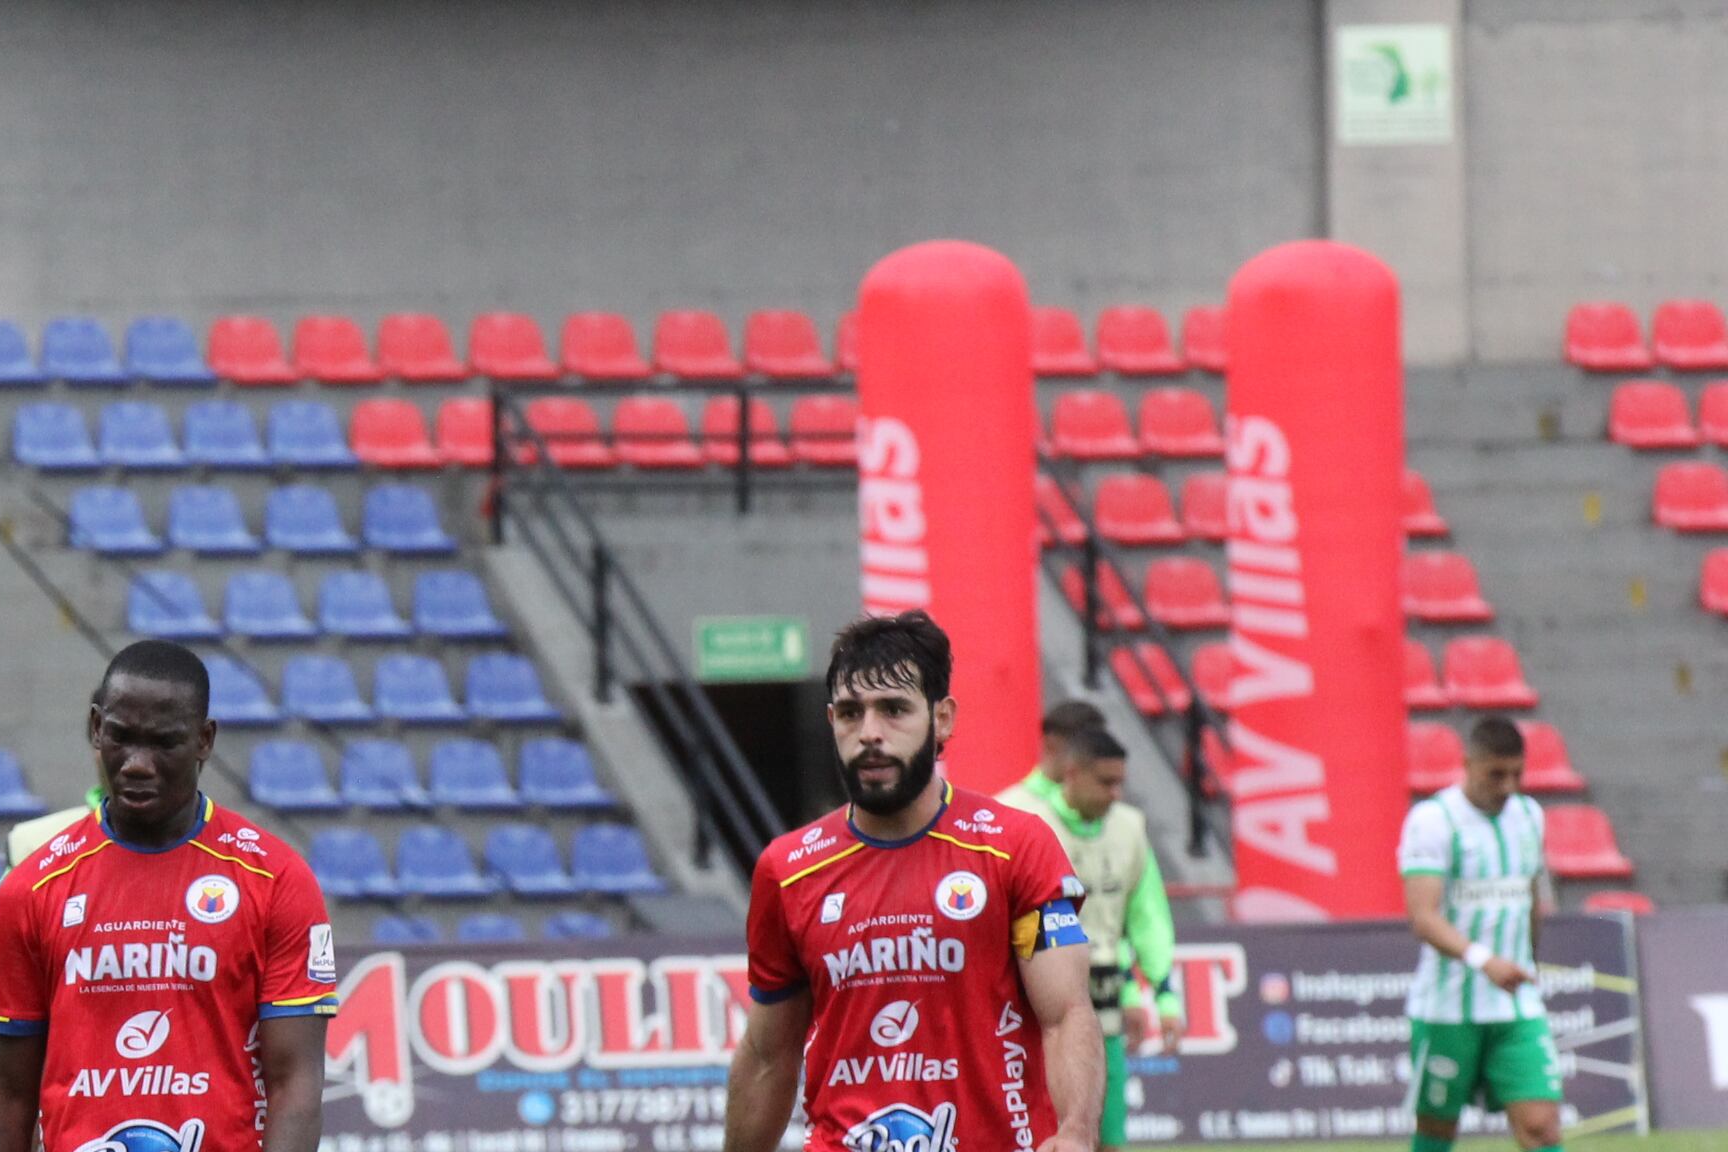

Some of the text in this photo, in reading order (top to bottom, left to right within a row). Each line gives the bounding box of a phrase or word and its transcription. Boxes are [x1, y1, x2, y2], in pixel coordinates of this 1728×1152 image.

[1225, 415, 1339, 876] AV Villas
[786, 834, 837, 863] AV Villas
[94, 919, 186, 933] AGUARDIENTE
[65, 931, 218, 985] NARIÑO
[823, 927, 965, 987] NARIÑO
[1296, 1012, 1411, 1045] Faceboo
[68, 1065, 210, 1097] AV Villas
[828, 1052, 959, 1087] AV Villas
